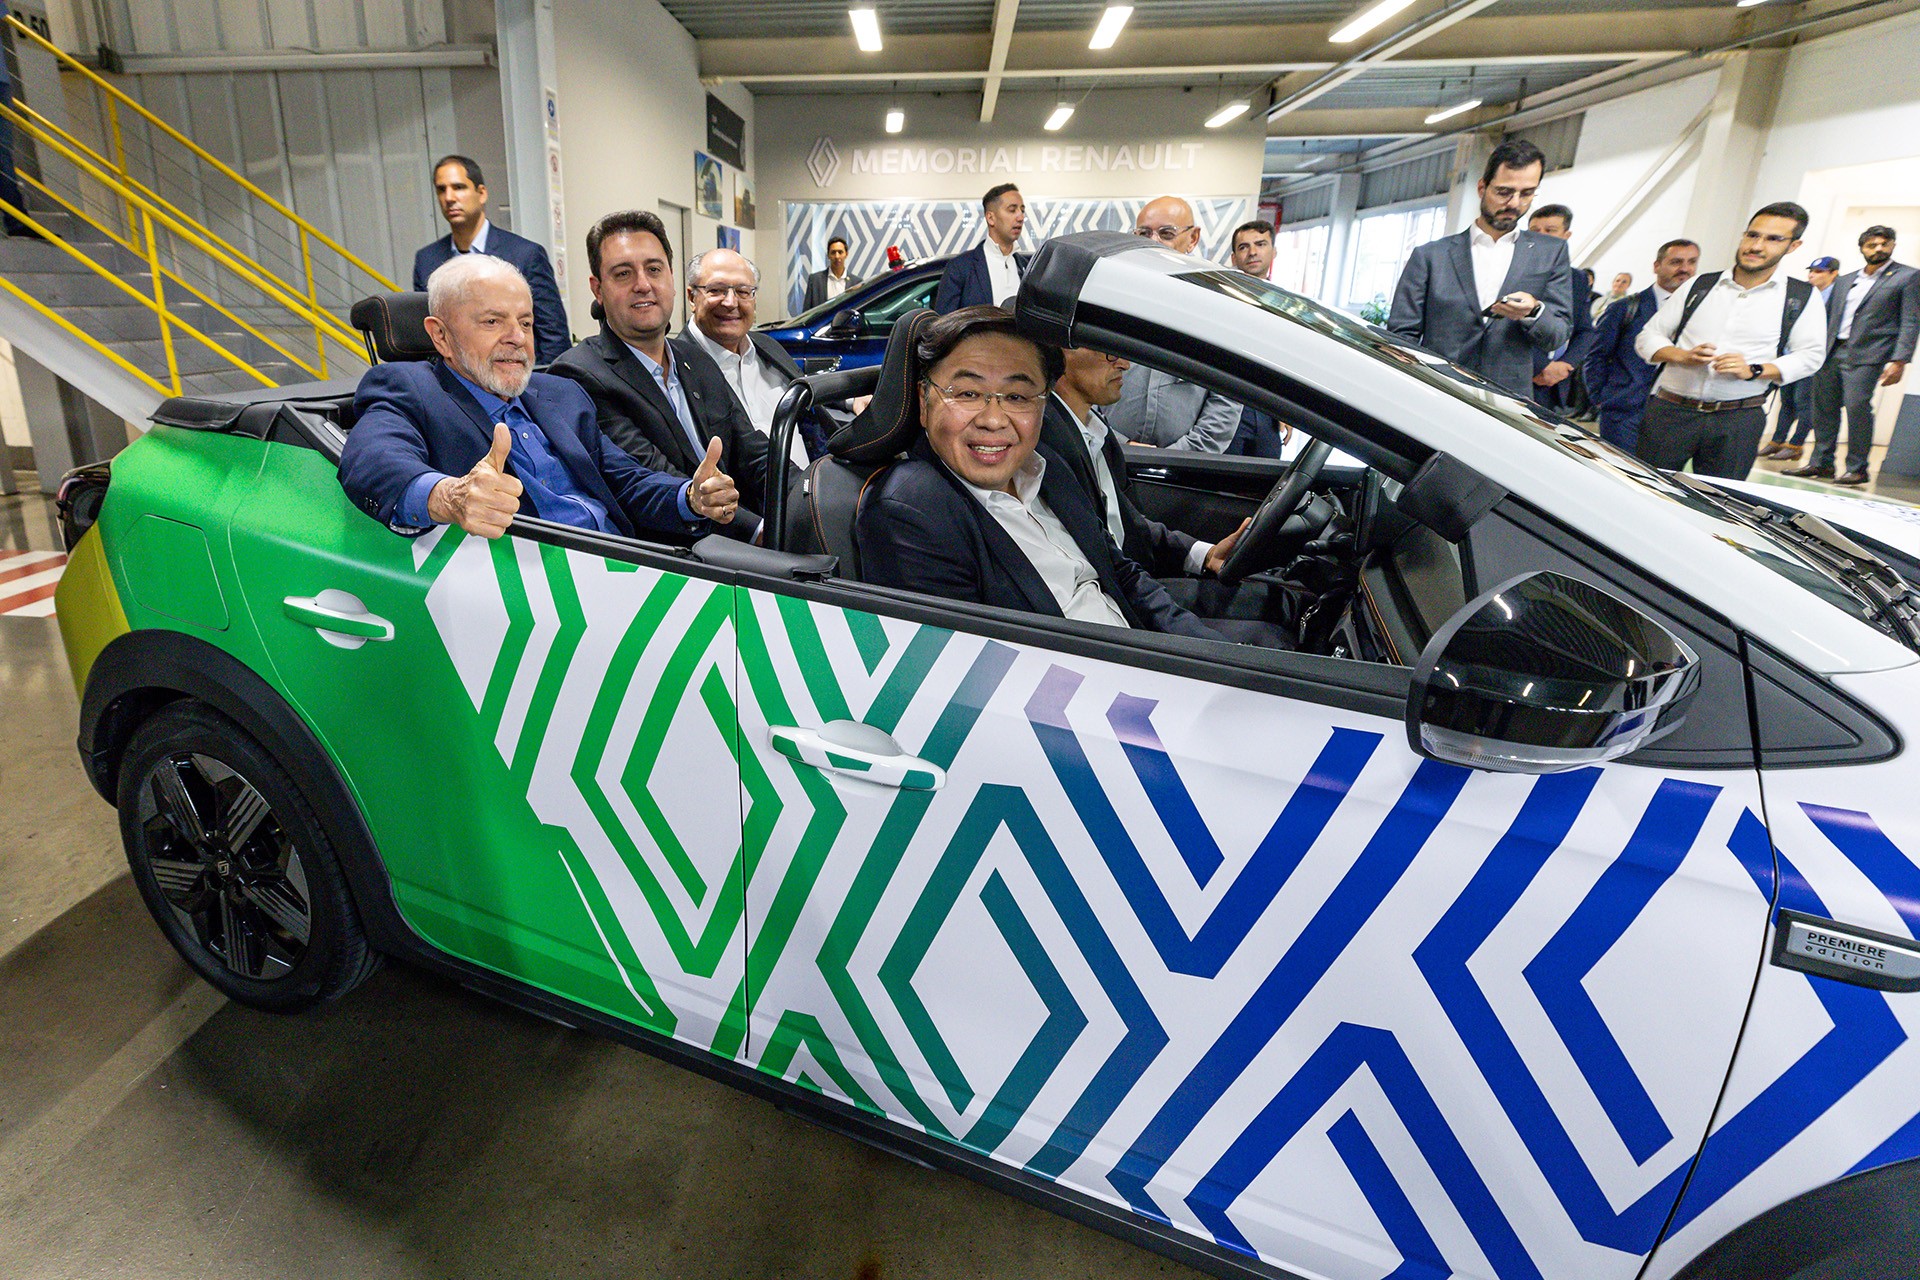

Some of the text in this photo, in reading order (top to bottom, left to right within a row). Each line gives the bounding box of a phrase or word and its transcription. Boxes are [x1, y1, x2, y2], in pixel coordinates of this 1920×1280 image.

[851, 142, 1204, 175] MEMORIAL RENAULT
[1804, 944, 1885, 970] edition
[1807, 932, 1887, 959] PREMIERE
